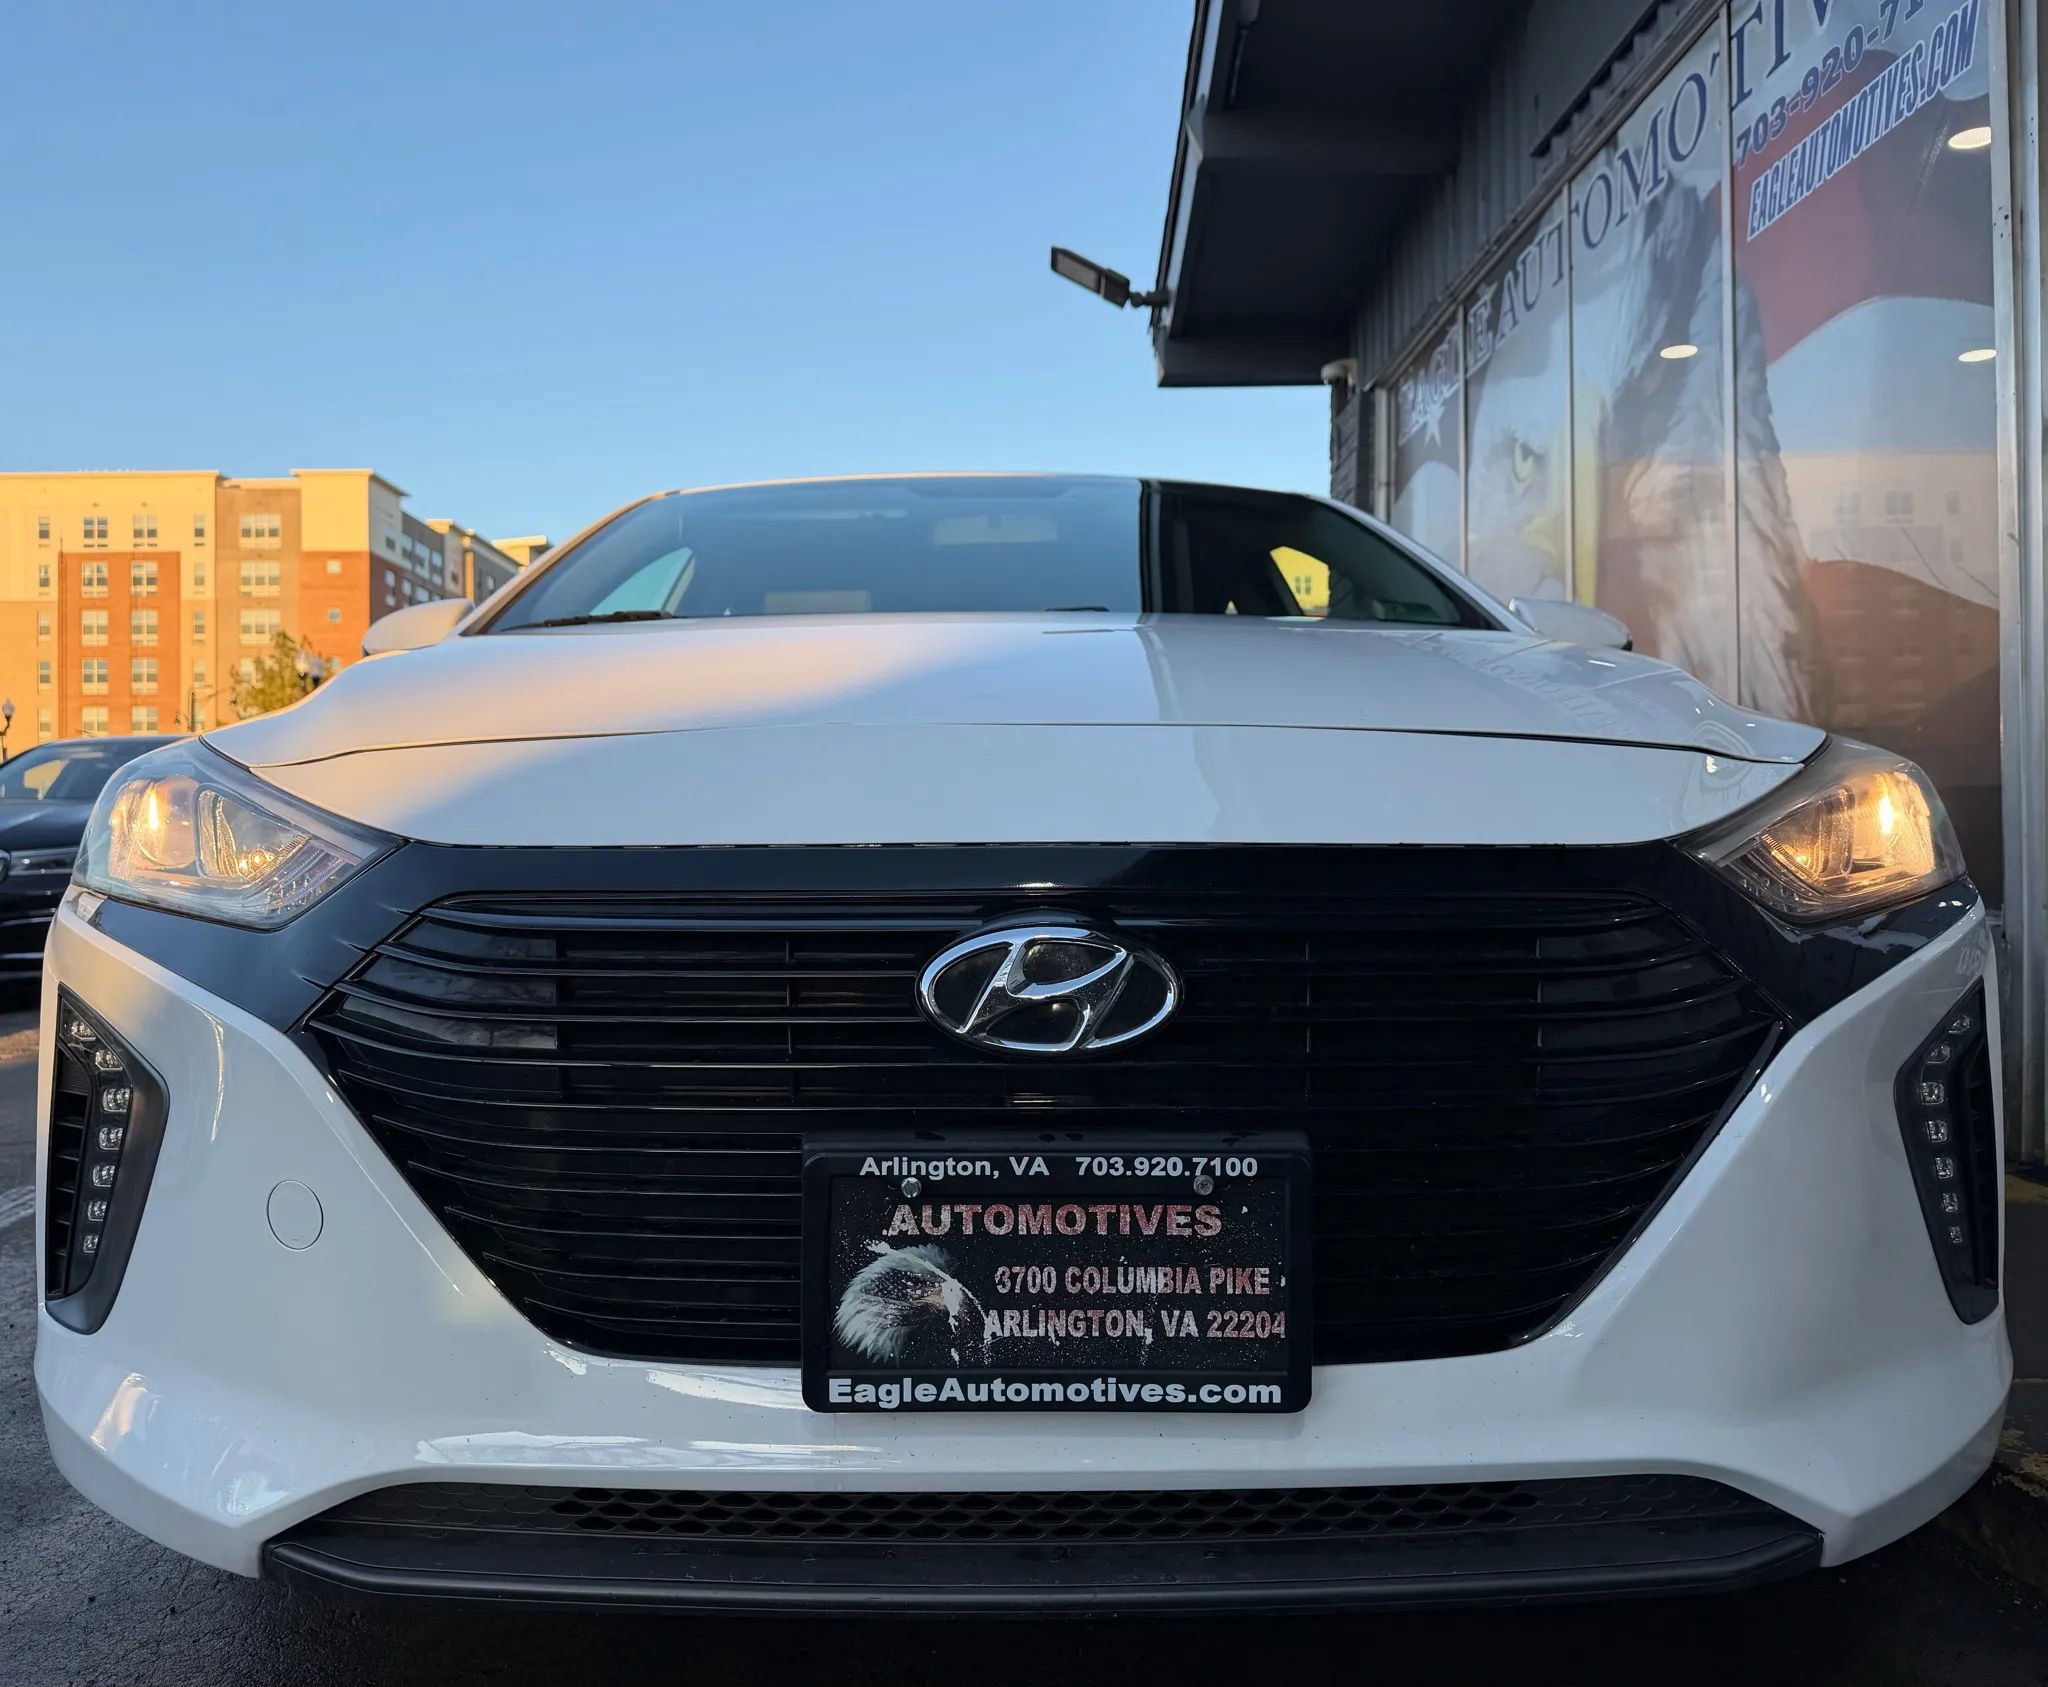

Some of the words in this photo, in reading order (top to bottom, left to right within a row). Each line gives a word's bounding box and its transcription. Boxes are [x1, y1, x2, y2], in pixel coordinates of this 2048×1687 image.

[1747, 0, 1981, 241] EAGLEAUTOMOTIVES.COM
[859, 1156, 1000, 1180] Arlington,
[1008, 1156, 1050, 1176] VA
[1075, 1156, 1258, 1177] 703.920.7100
[887, 1203, 1223, 1237] AUTOMOTIVES
[1065, 1266, 1202, 1294] COLUMBIA
[1210, 1267, 1270, 1295] PIKE
[1160, 1309, 1200, 1338] VA
[1206, 1310, 1286, 1339] 22204
[828, 1377, 1282, 1410] EagleAutomotives.com
